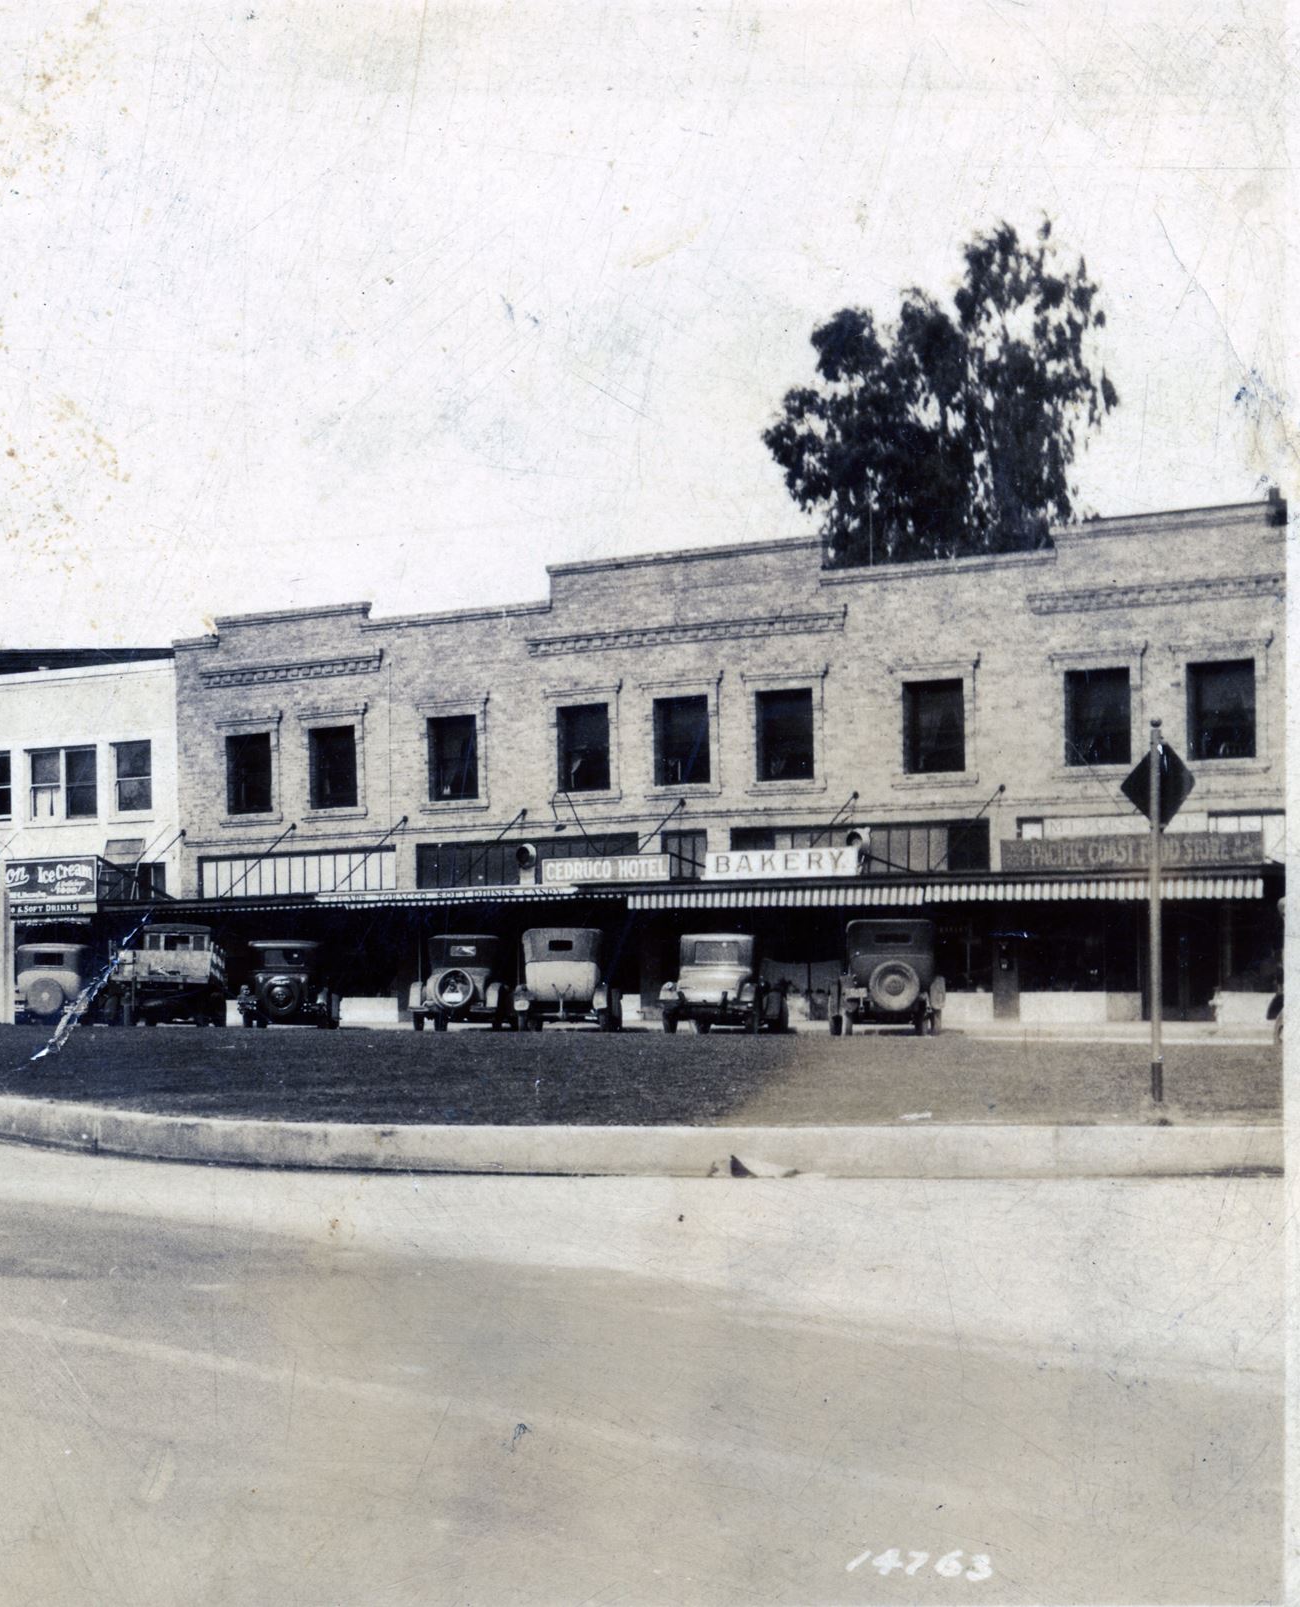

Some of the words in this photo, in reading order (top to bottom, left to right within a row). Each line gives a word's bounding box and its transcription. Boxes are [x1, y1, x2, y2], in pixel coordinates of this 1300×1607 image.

[1030, 841, 1084, 865] PACIFIC
[1088, 838, 1134, 863] COAST
[1140, 836, 1181, 862] FOD
[1184, 834, 1230, 861] STORE
[545, 861, 611, 880] CEDRUCO
[618, 859, 667, 879] HOTEL
[715, 850, 844, 874] BAKERY
[5, 866, 31, 888] on
[37, 866, 56, 884] Ice
[55, 863, 93, 882] Cream
[379, 891, 427, 900] TOBACCO
[437, 889, 467, 898] SOFT
[474, 888, 515, 897] DRINKS
[23, 905, 44, 913] SOFT
[45, 903, 78, 912] DRINKS
